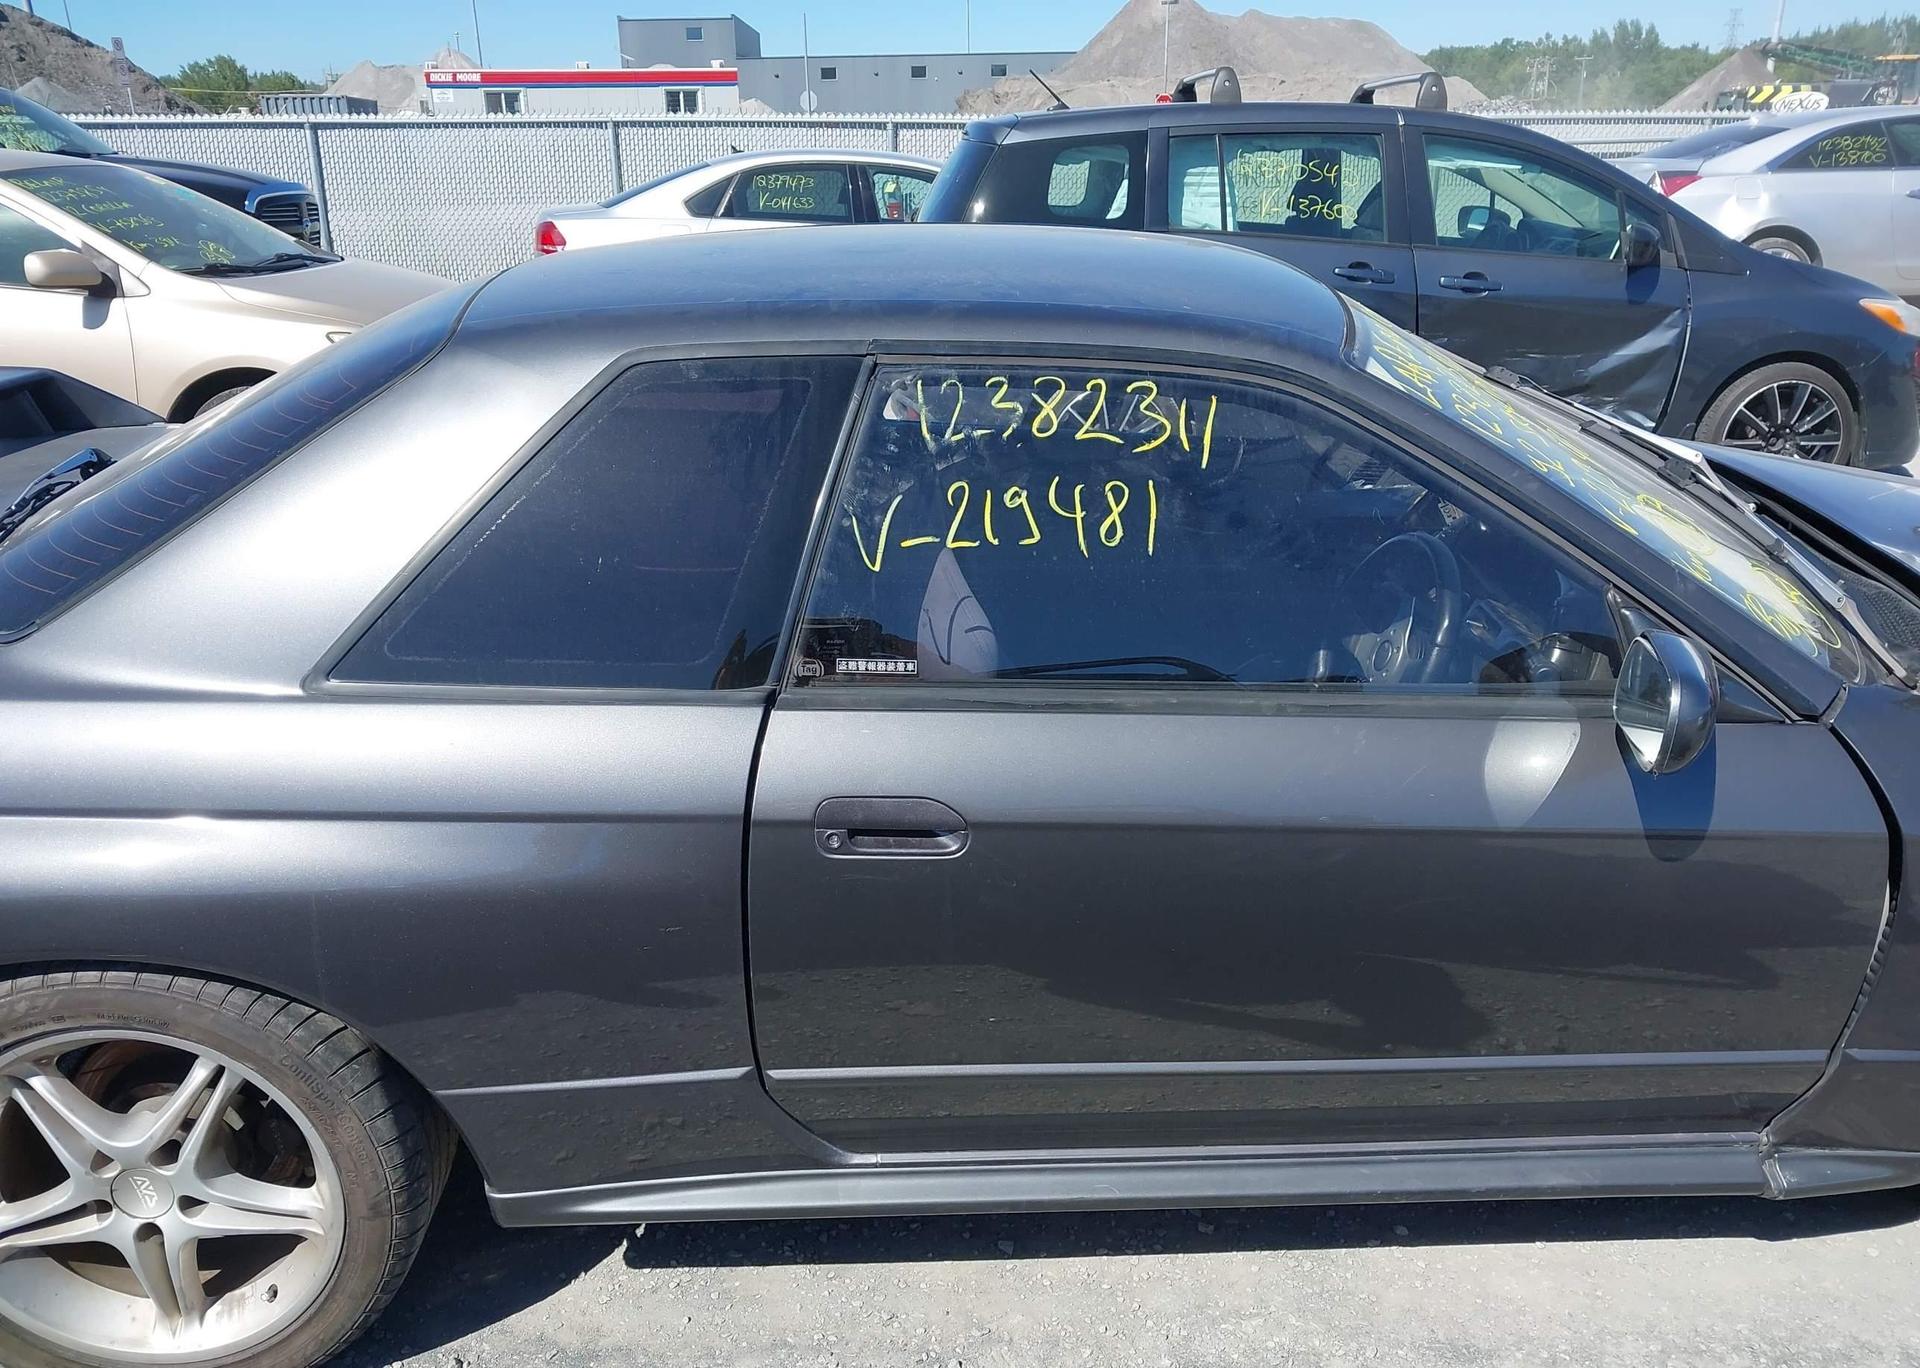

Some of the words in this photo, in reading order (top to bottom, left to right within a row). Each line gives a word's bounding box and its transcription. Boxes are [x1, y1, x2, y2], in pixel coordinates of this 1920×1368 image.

[429, 72, 454, 82] DICKIE
[456, 72, 481, 82] MOORE
[1778, 96, 1823, 112] NEXUS
[752, 174, 815, 193] 12379473
[916, 376, 1218, 469] 12382311
[801, 664, 817, 675] Tag
